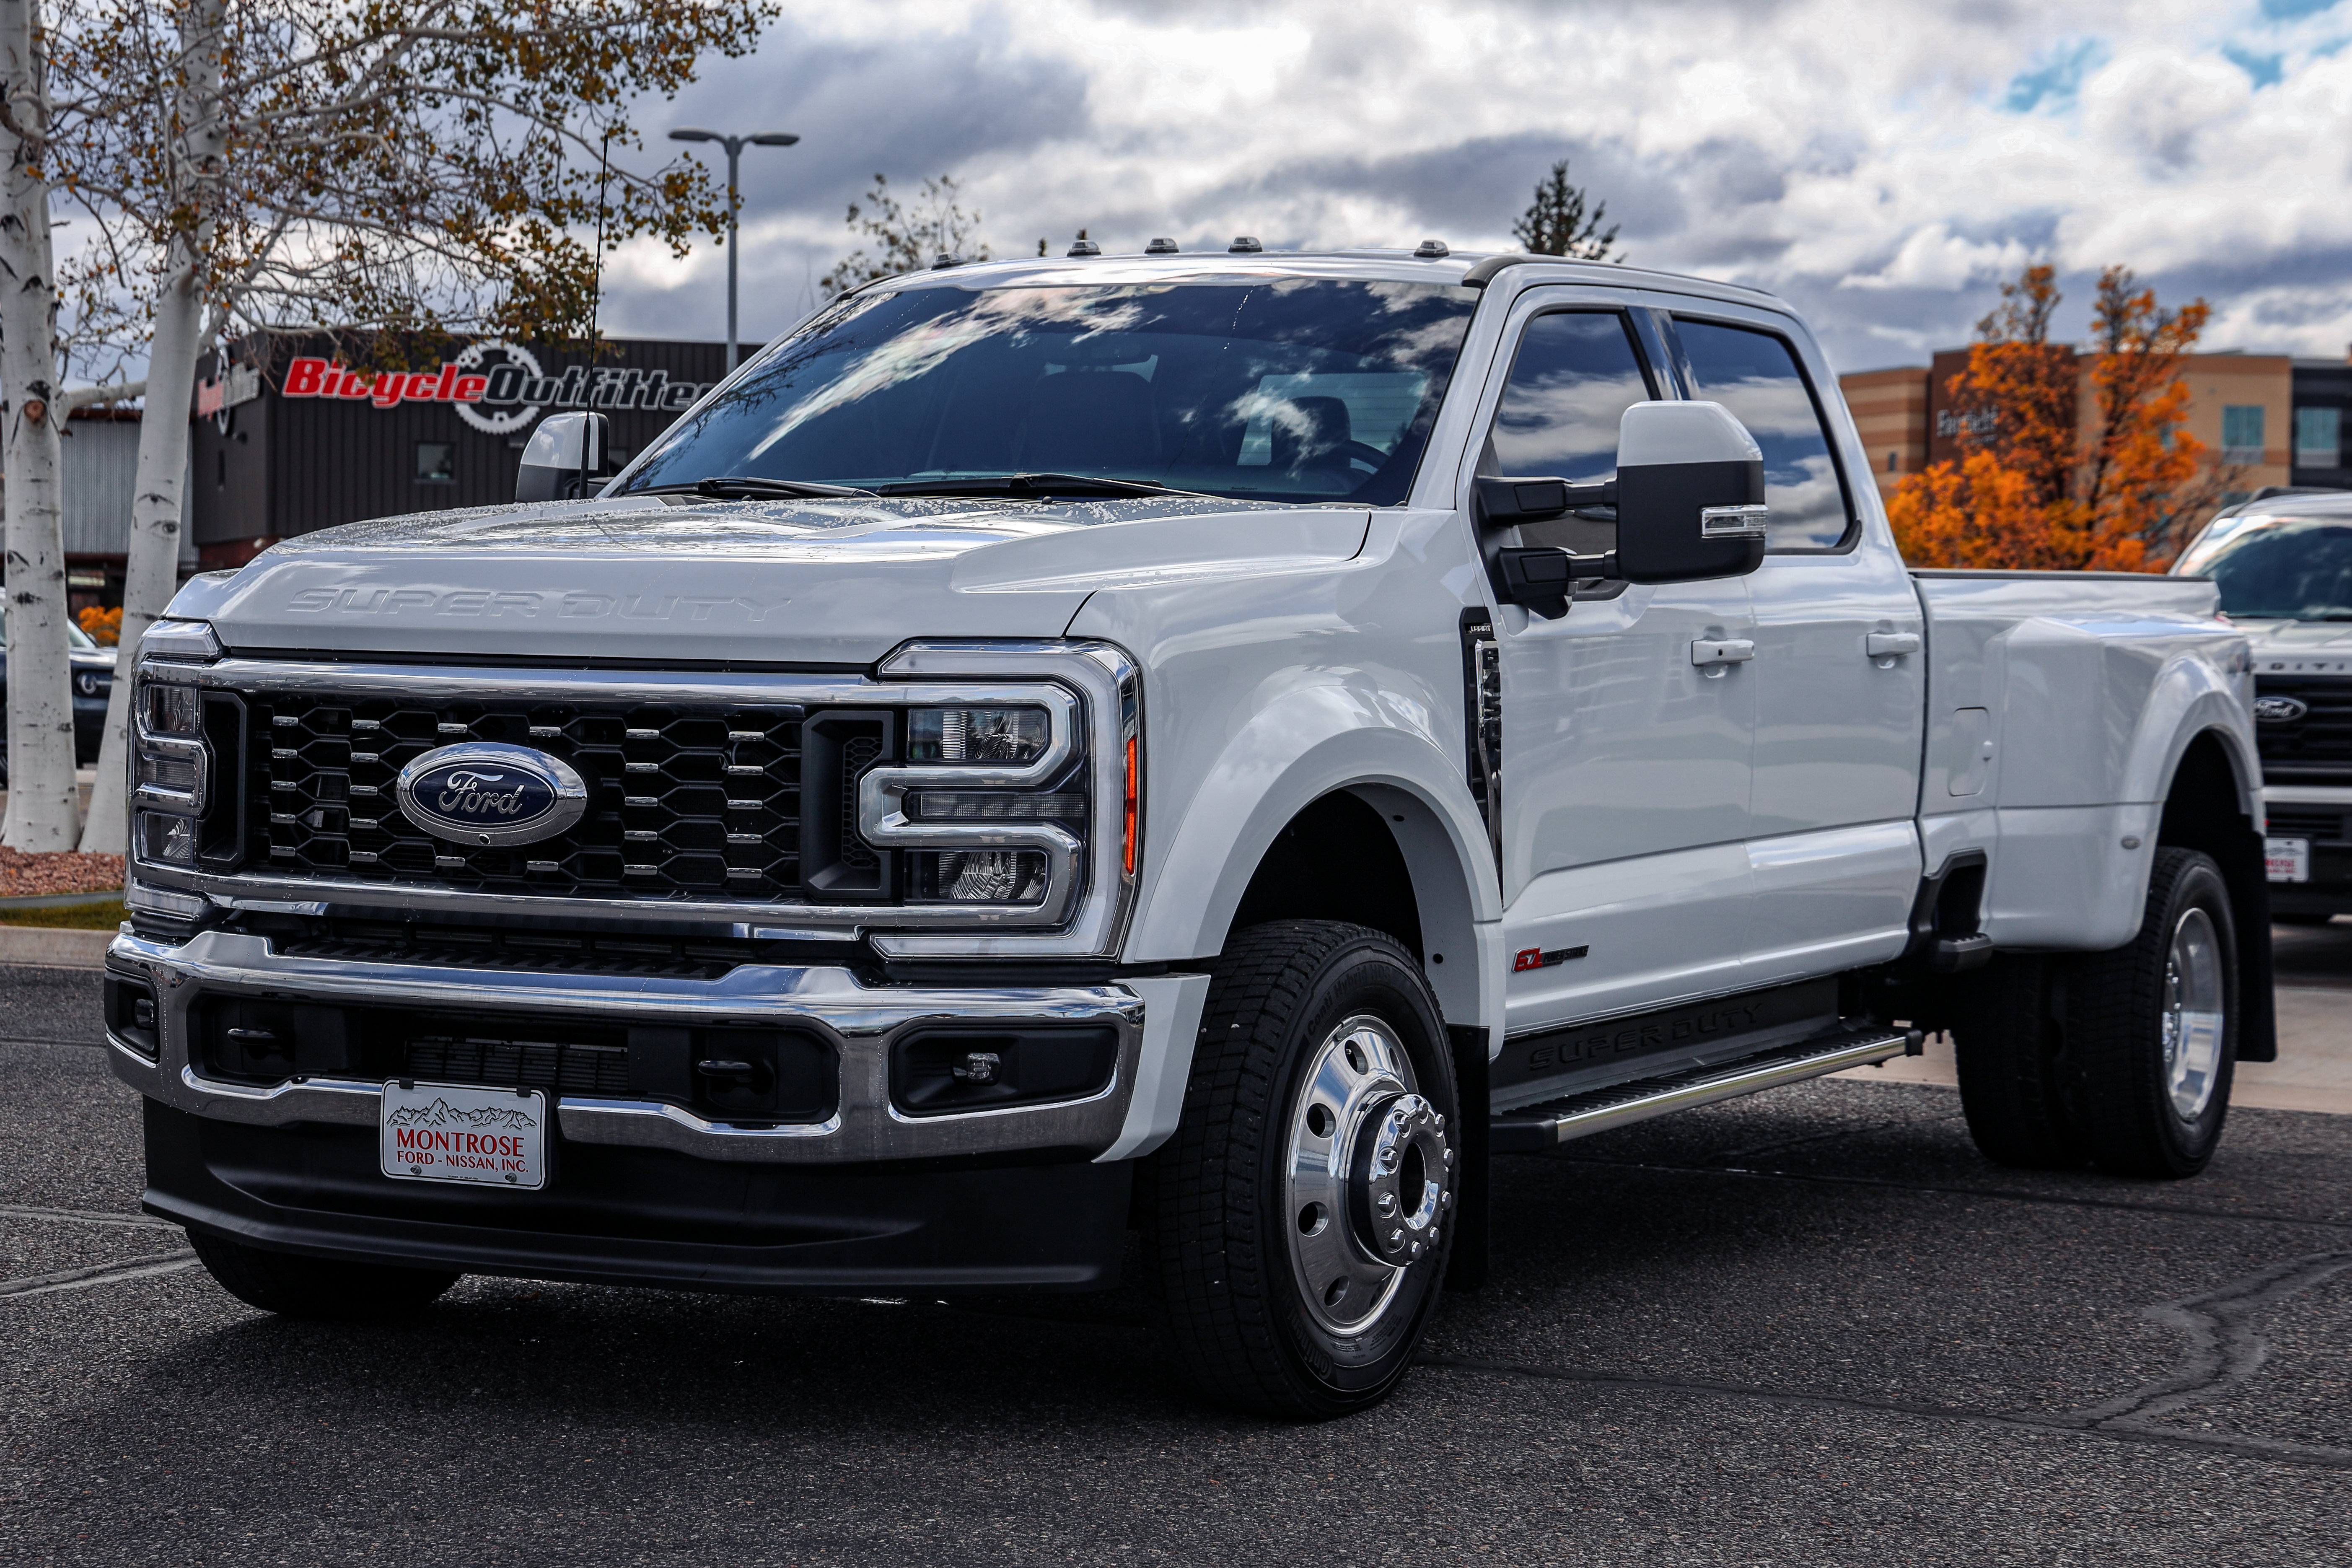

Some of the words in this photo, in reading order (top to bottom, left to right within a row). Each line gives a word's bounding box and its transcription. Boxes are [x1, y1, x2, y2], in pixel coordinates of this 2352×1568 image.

[285, 588, 544, 617] SUPER
[557, 594, 791, 621] DUTY
[438, 770, 525, 815] Ford
[1307, 991, 1333, 1036] Conti
[1529, 1025, 1663, 1071] SUPER
[1672, 1003, 1762, 1040] DUTY
[396, 1127, 525, 1157] MONTROSE
[396, 1150, 434, 1164] FORD
[446, 1154, 498, 1172] NISSAN,
[502, 1158, 528, 1173] INC.
